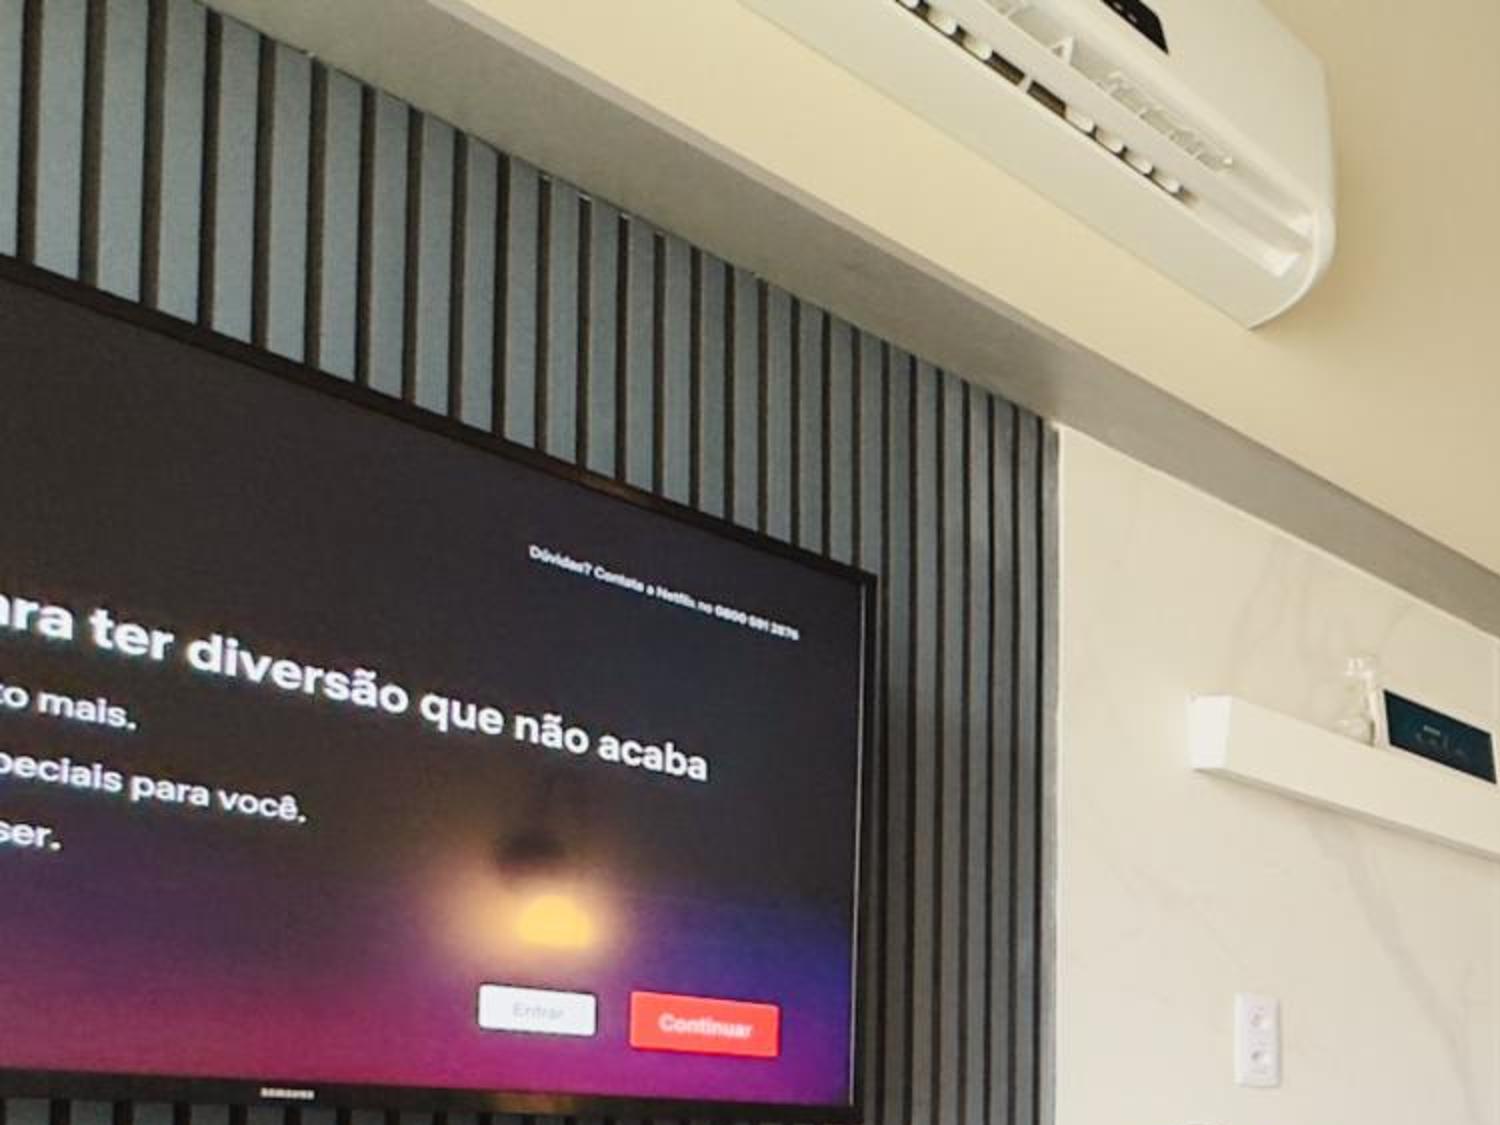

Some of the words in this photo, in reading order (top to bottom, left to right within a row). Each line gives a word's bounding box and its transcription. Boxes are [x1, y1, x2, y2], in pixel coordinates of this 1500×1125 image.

[37, 691, 137, 731] mais.
[88, 608, 175, 661] ter
[185, 633, 409, 714] diversão
[419, 692, 505, 735] que
[513, 712, 590, 755] não
[597, 734, 708, 782] acaba
[130, 775, 211, 807] para
[217, 789, 307, 824] você.
[658, 1011, 754, 1040] Continuar
